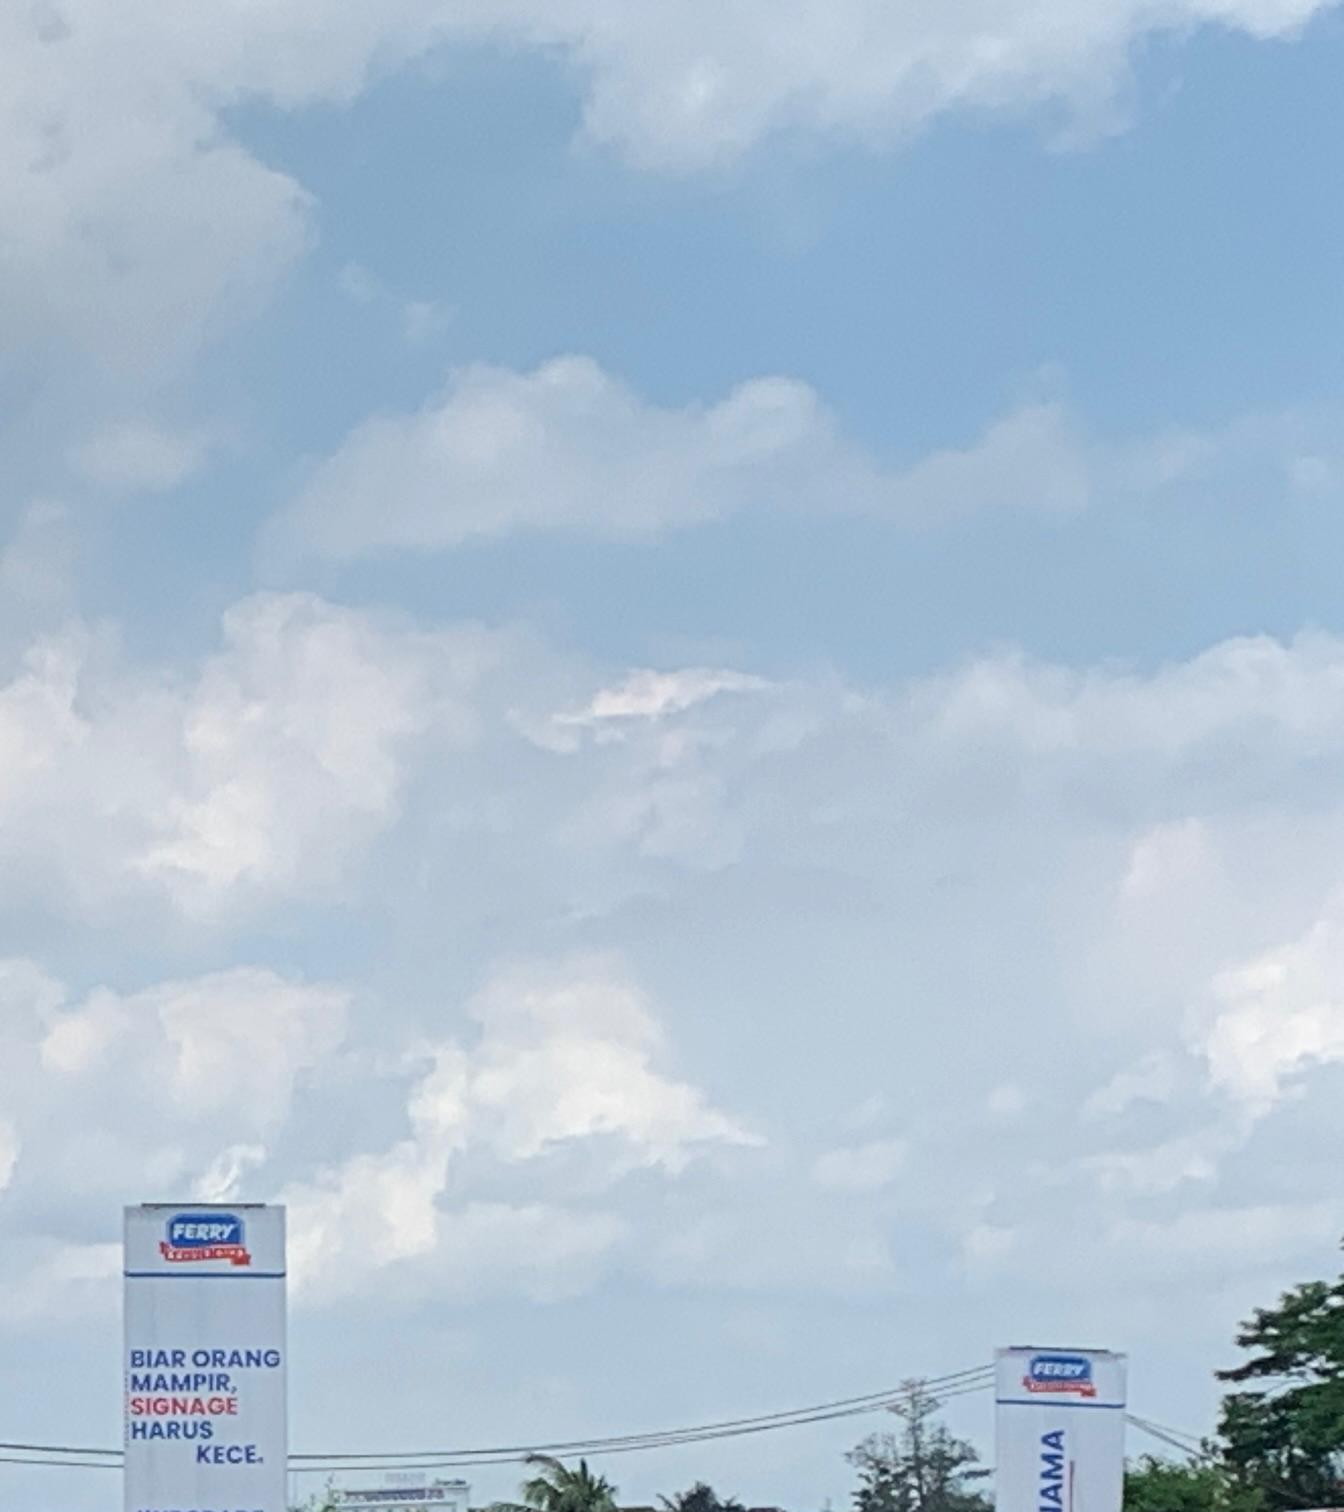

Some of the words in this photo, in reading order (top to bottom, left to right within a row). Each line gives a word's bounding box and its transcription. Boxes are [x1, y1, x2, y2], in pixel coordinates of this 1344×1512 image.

[172, 1223, 233, 1239] FERRY
[130, 1349, 186, 1368] BIAR
[191, 1349, 281, 1368] ORANG
[130, 1373, 237, 1394] MAMPIR,
[130, 1397, 238, 1415] SIGNAGE
[131, 1420, 213, 1440] HARUS
